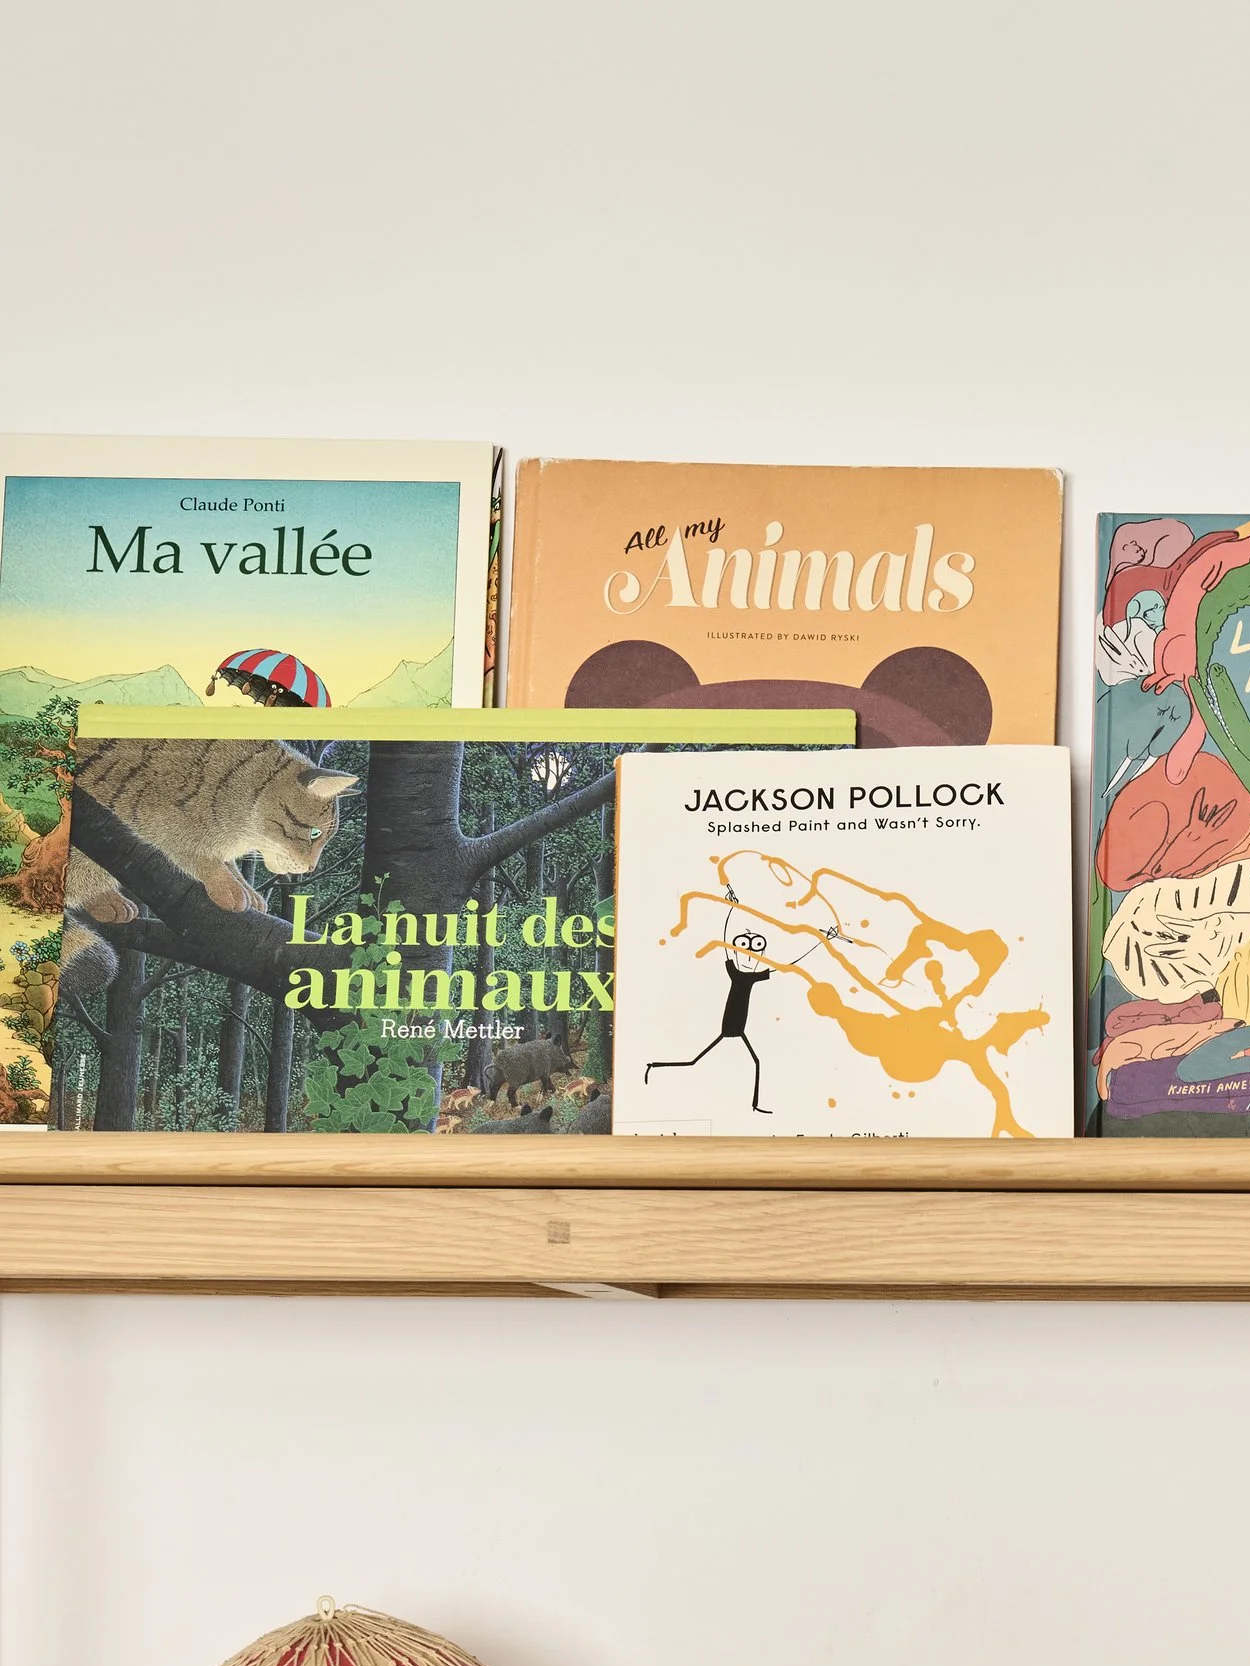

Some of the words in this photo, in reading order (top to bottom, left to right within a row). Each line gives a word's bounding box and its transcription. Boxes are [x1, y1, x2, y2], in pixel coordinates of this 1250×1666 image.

[180, 497, 238, 513] Claude
[242, 498, 286, 513] Ponti
[86, 525, 184, 575] Ma
[200, 526, 373, 577] vallée
[623, 525, 668, 555] All
[683, 516, 726, 543] my
[603, 520, 977, 615] Animals
[706, 631, 773, 641] ILLUSTRATED
[777, 632, 789, 641] BY
[792, 632, 828, 642] DAWID
[831, 632, 860, 642] RYSKI
[684, 787, 835, 813] JACKSON
[850, 781, 1005, 810] POLLOCK
[707, 818, 782, 836] Splashed
[788, 817, 830, 833] Paint
[837, 817, 868, 831] and
[874, 816, 930, 831] Wasn't
[935, 815, 981, 834] Sorry.
[286, 894, 364, 946] La
[383, 899, 507, 946] nuit
[522, 896, 615, 949] des
[284, 950, 614, 1012] animaux
[380, 1019, 436, 1039] René
[443, 1019, 525, 1040] Mettler
[75, 1094, 84, 1132] ALLIMARD
